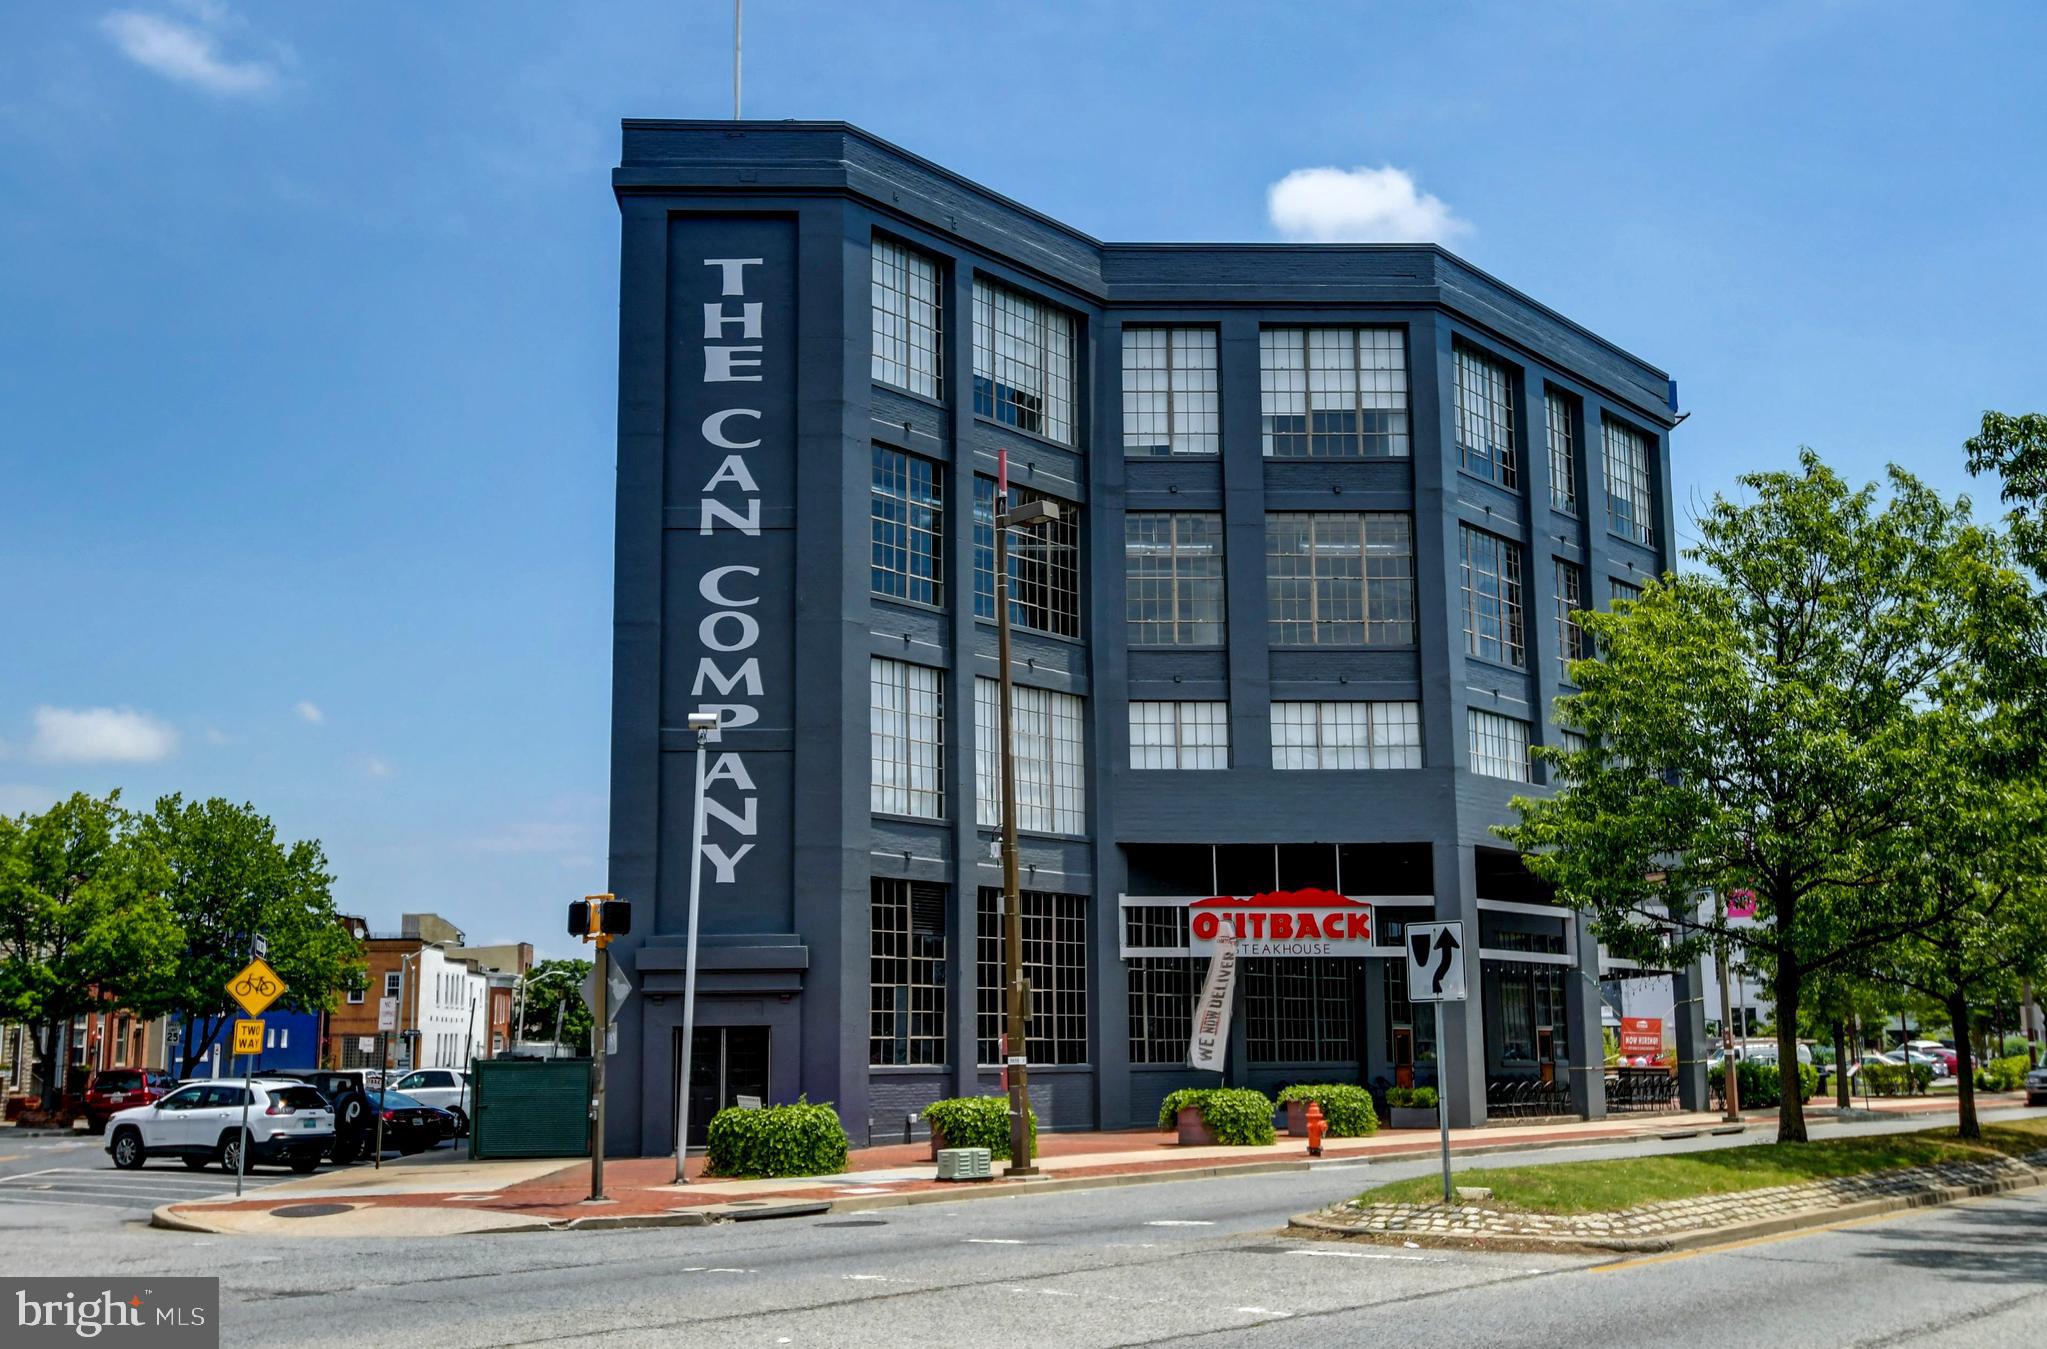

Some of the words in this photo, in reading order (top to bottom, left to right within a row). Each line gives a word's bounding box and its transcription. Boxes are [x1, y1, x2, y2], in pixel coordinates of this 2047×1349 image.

[703, 257, 763, 383] THE
[700, 408, 762, 536] CAN
[690, 565, 765, 883] COMPANY
[241, 1025, 260, 1036] TWO
[1202, 1010, 1221, 1035] NOW
[167, 1032, 179, 1042] 25
[239, 1039, 260, 1049] WAY
[1198, 1037, 1215, 1062] WE
[1625, 1036, 1638, 1045] NOW
